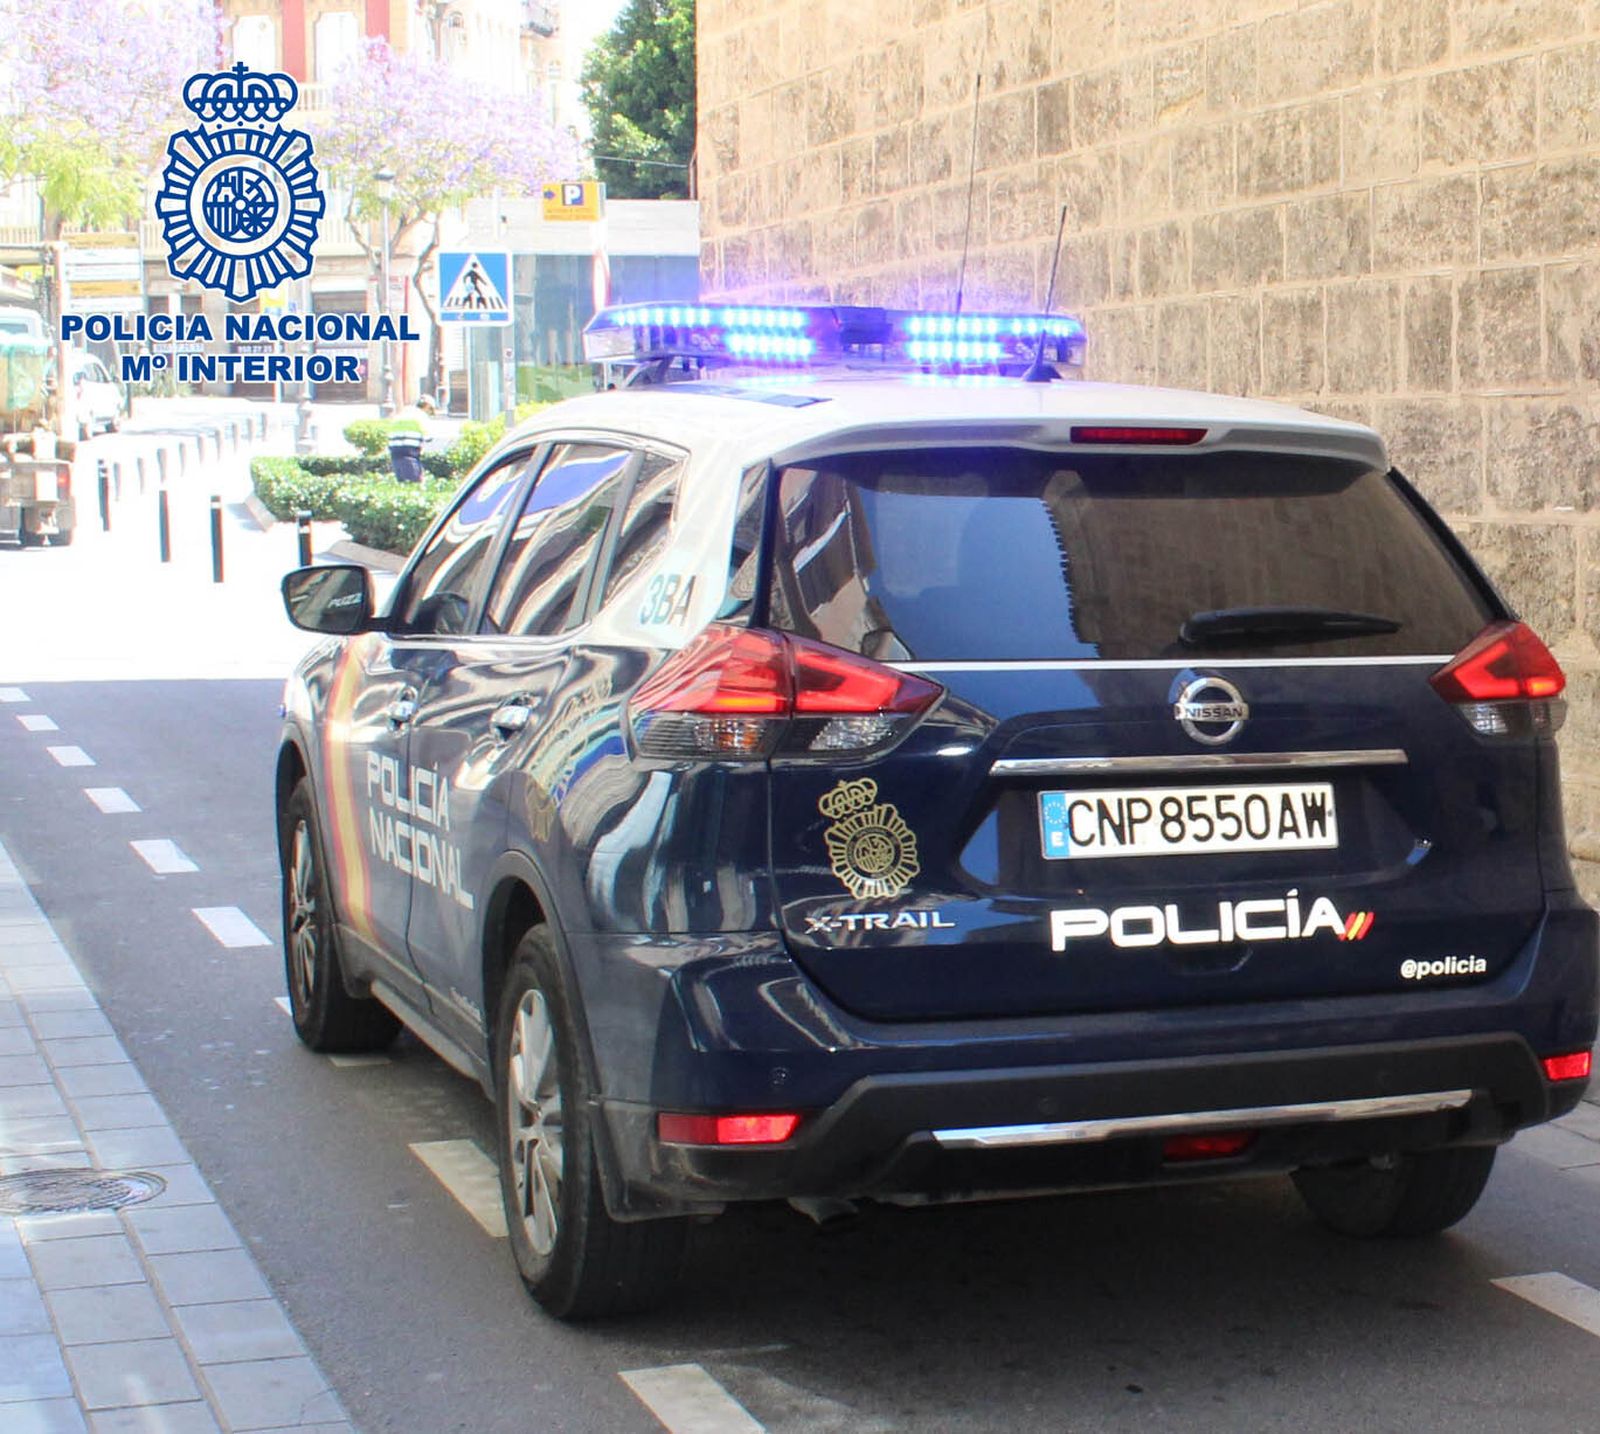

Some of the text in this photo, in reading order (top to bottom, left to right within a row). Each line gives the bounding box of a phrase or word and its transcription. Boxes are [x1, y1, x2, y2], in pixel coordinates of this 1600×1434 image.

[565, 185, 581, 205] P
[640, 574, 697, 627] 3BA
[1185, 706, 1244, 718] NISSAN
[366, 751, 450, 832] POLICÍA
[1051, 832, 1064, 848] E
[368, 808, 474, 910] NACIONAL
[804, 910, 957, 934] X-TRAIL
[1050, 888, 1347, 952] POLICÍA
[1400, 955, 1487, 980] @policia
